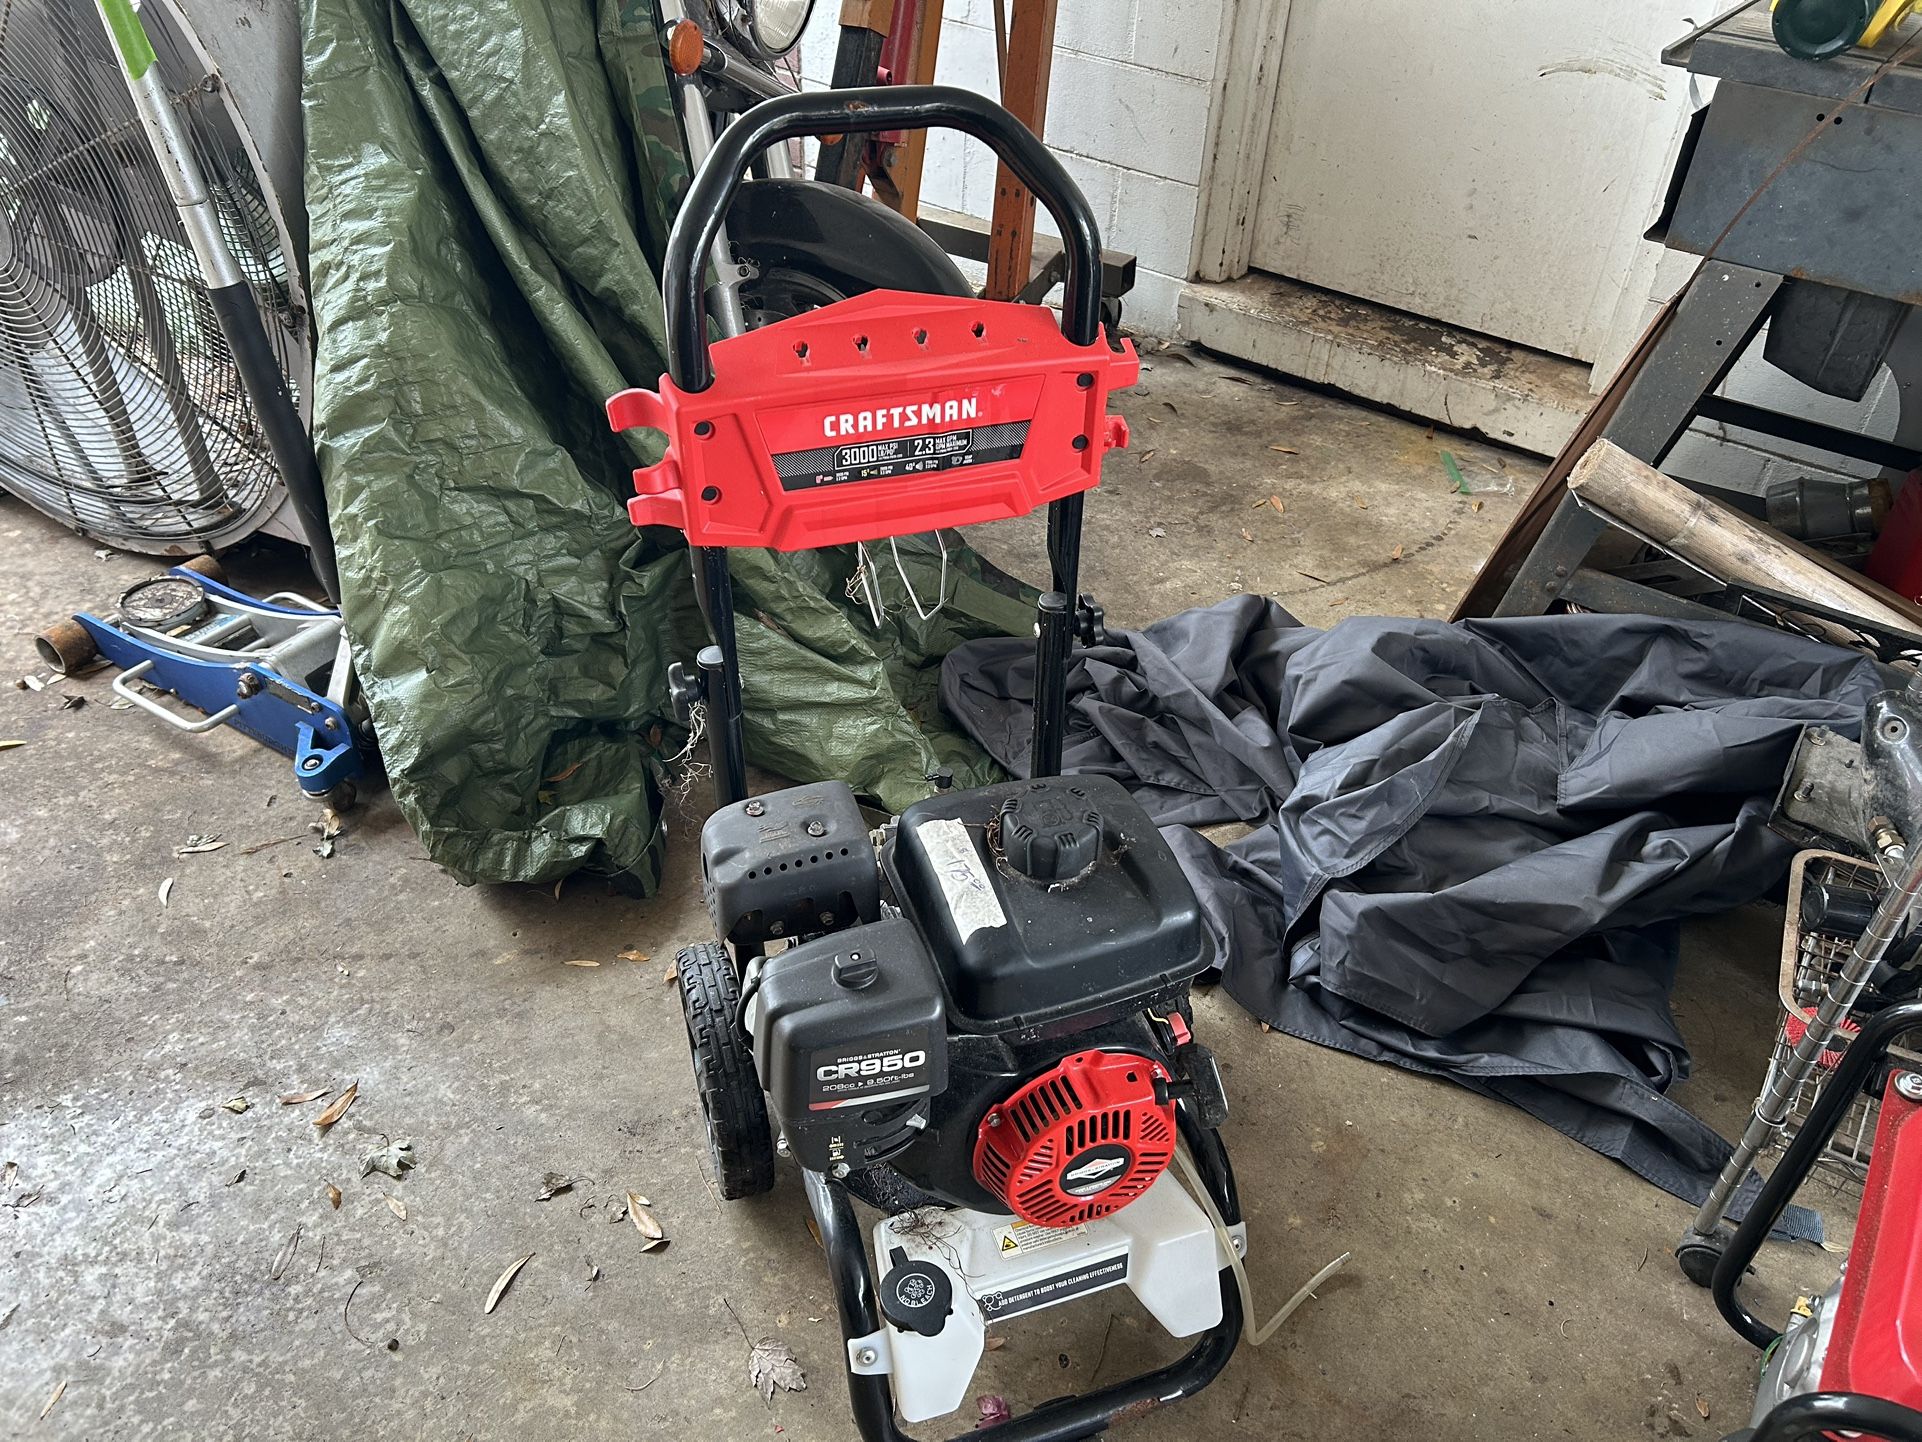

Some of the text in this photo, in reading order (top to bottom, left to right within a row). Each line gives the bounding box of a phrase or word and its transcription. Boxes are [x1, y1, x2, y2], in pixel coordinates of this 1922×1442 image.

[823, 397, 977, 437] CRAFTSMAN
[878, 442, 899, 452] MAX PSI
[914, 438, 934, 456] 2.3
[935, 437, 946, 445] MAX
[842, 445, 877, 465] 3000
[816, 1050, 926, 1081] CR950
[822, 1083, 855, 1092] 208cc
[1008, 1290, 1034, 1304] DETERGENT
[1034, 1288, 1041, 1296] TO
[1040, 1283, 1055, 1294] BOOST
[1055, 1279, 1068, 1289] YOUR
[1067, 1272, 1090, 1285] CLEANING
[1089, 1262, 1124, 1279] EFFECTIVENESS
[910, 1284, 933, 1306] BLEACH
